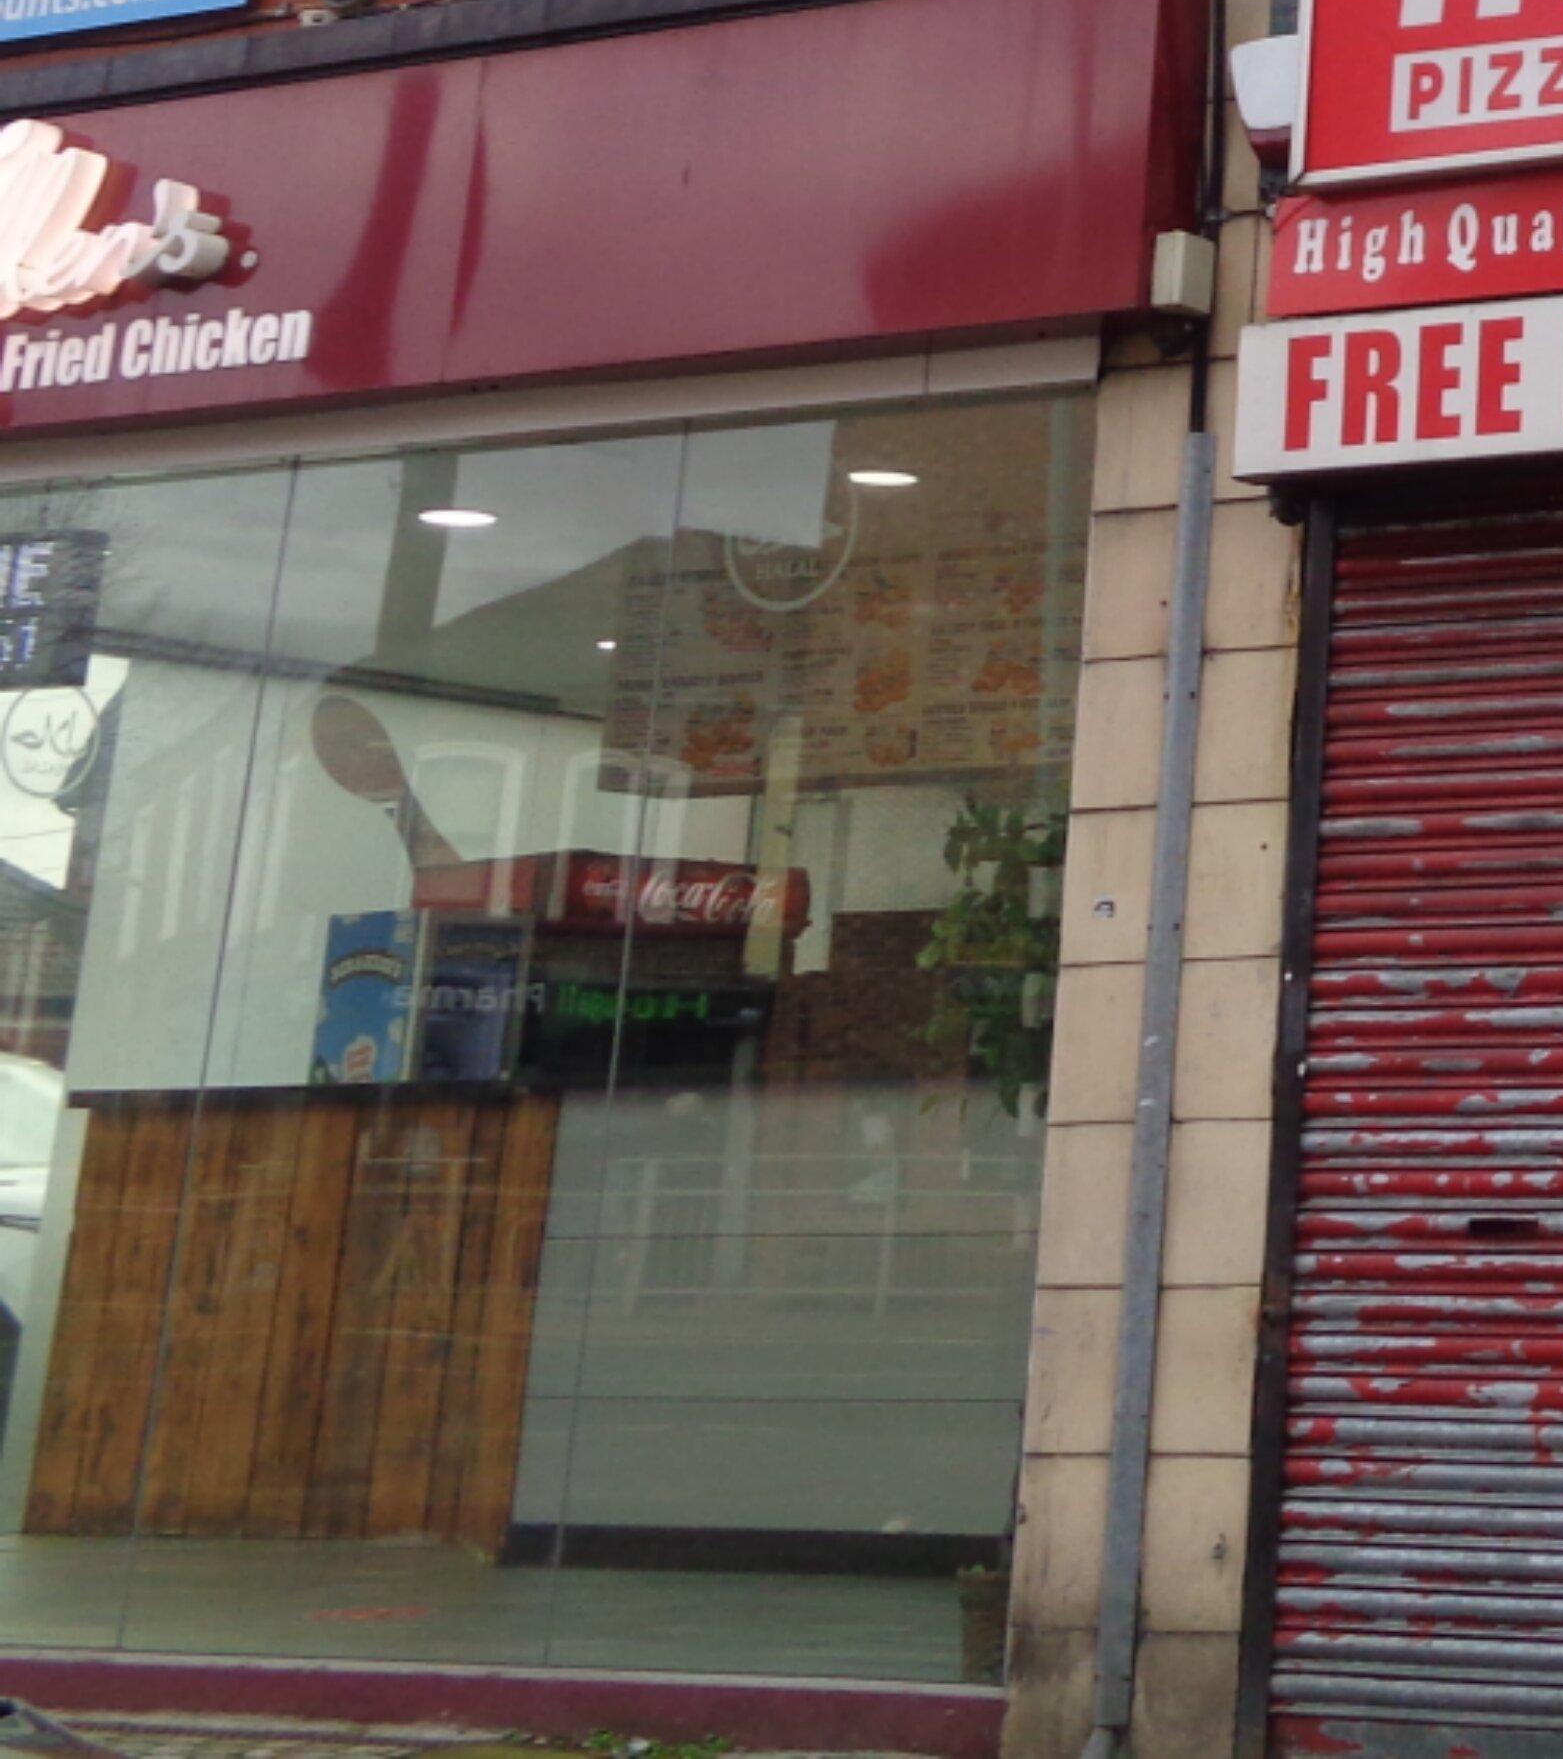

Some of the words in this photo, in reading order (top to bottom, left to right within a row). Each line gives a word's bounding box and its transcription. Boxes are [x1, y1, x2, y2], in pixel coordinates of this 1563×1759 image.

[1294, 205, 1426, 281] High
[0, 322, 117, 391] Fried
[120, 307, 314, 379] Chicken
[1283, 315, 1524, 452] FREE
